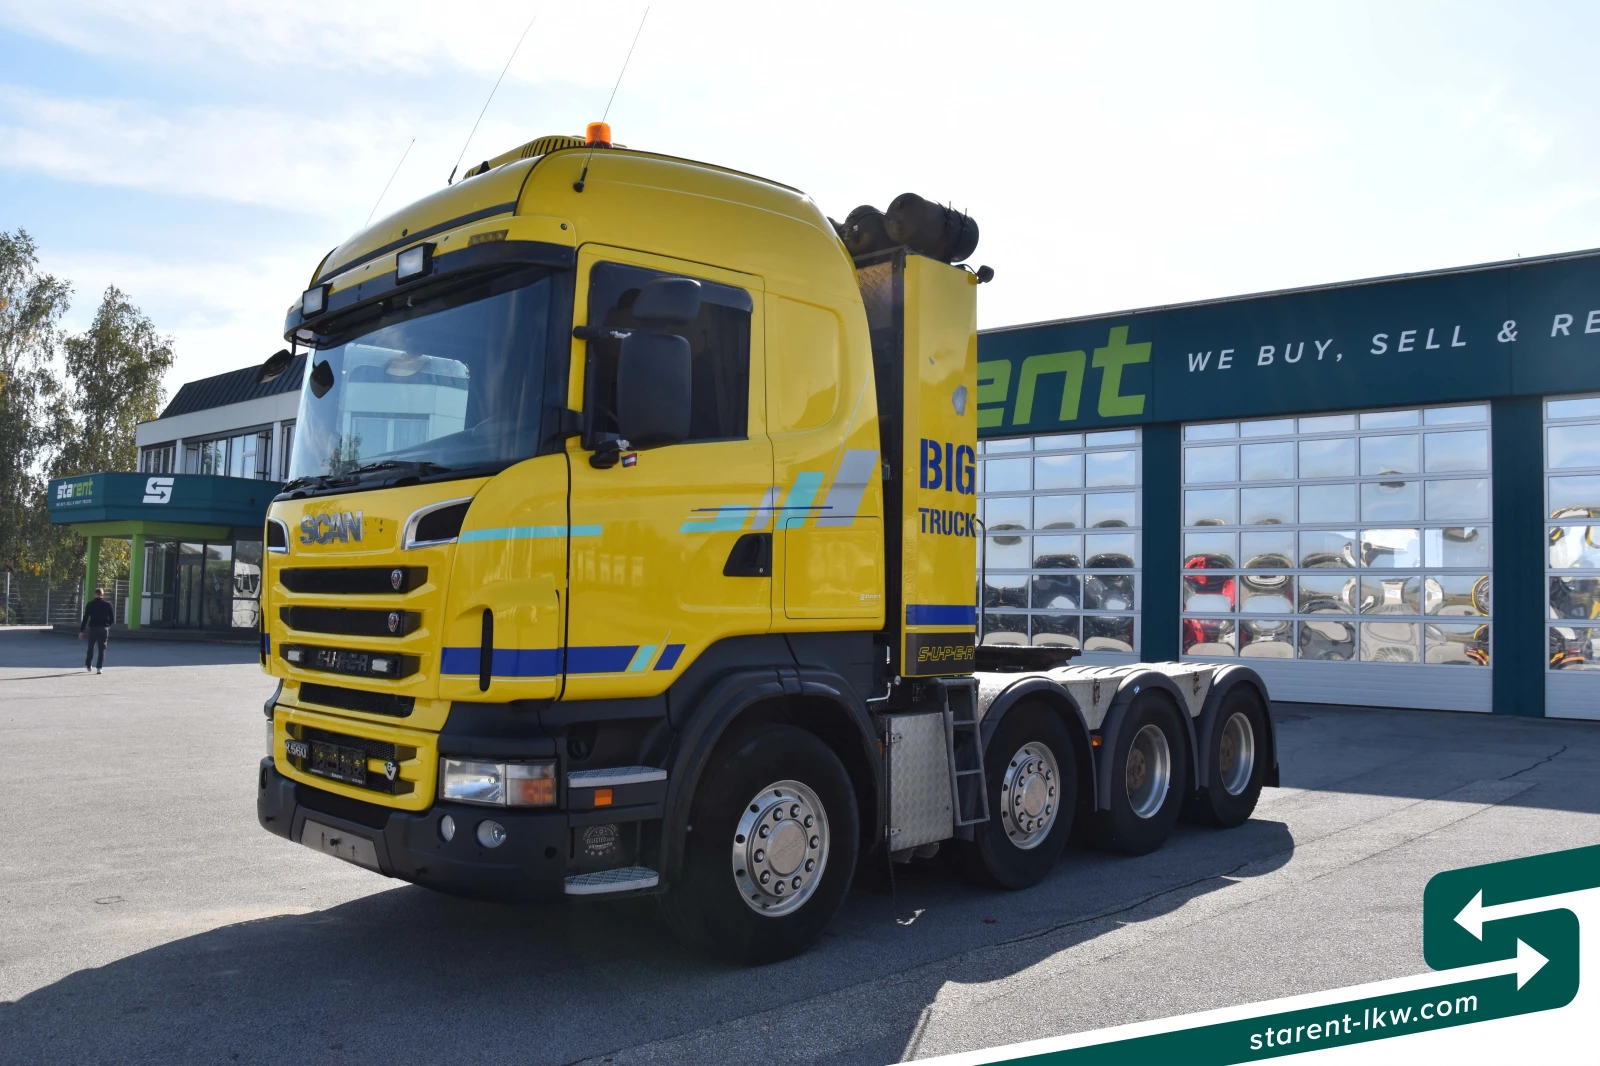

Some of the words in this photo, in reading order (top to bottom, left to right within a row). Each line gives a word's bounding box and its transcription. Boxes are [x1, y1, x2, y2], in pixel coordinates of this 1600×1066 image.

[1188, 349, 1235, 372] WE
[1257, 339, 1343, 366] BUY,
[1370, 325, 1467, 355] SELL
[1497, 320, 1519, 343] &
[920, 438, 976, 495] BIG
[57, 478, 93, 499] starent
[300, 510, 364, 545] SCAN
[918, 507, 977, 537] TRUCK
[917, 646, 975, 662] SUPER
